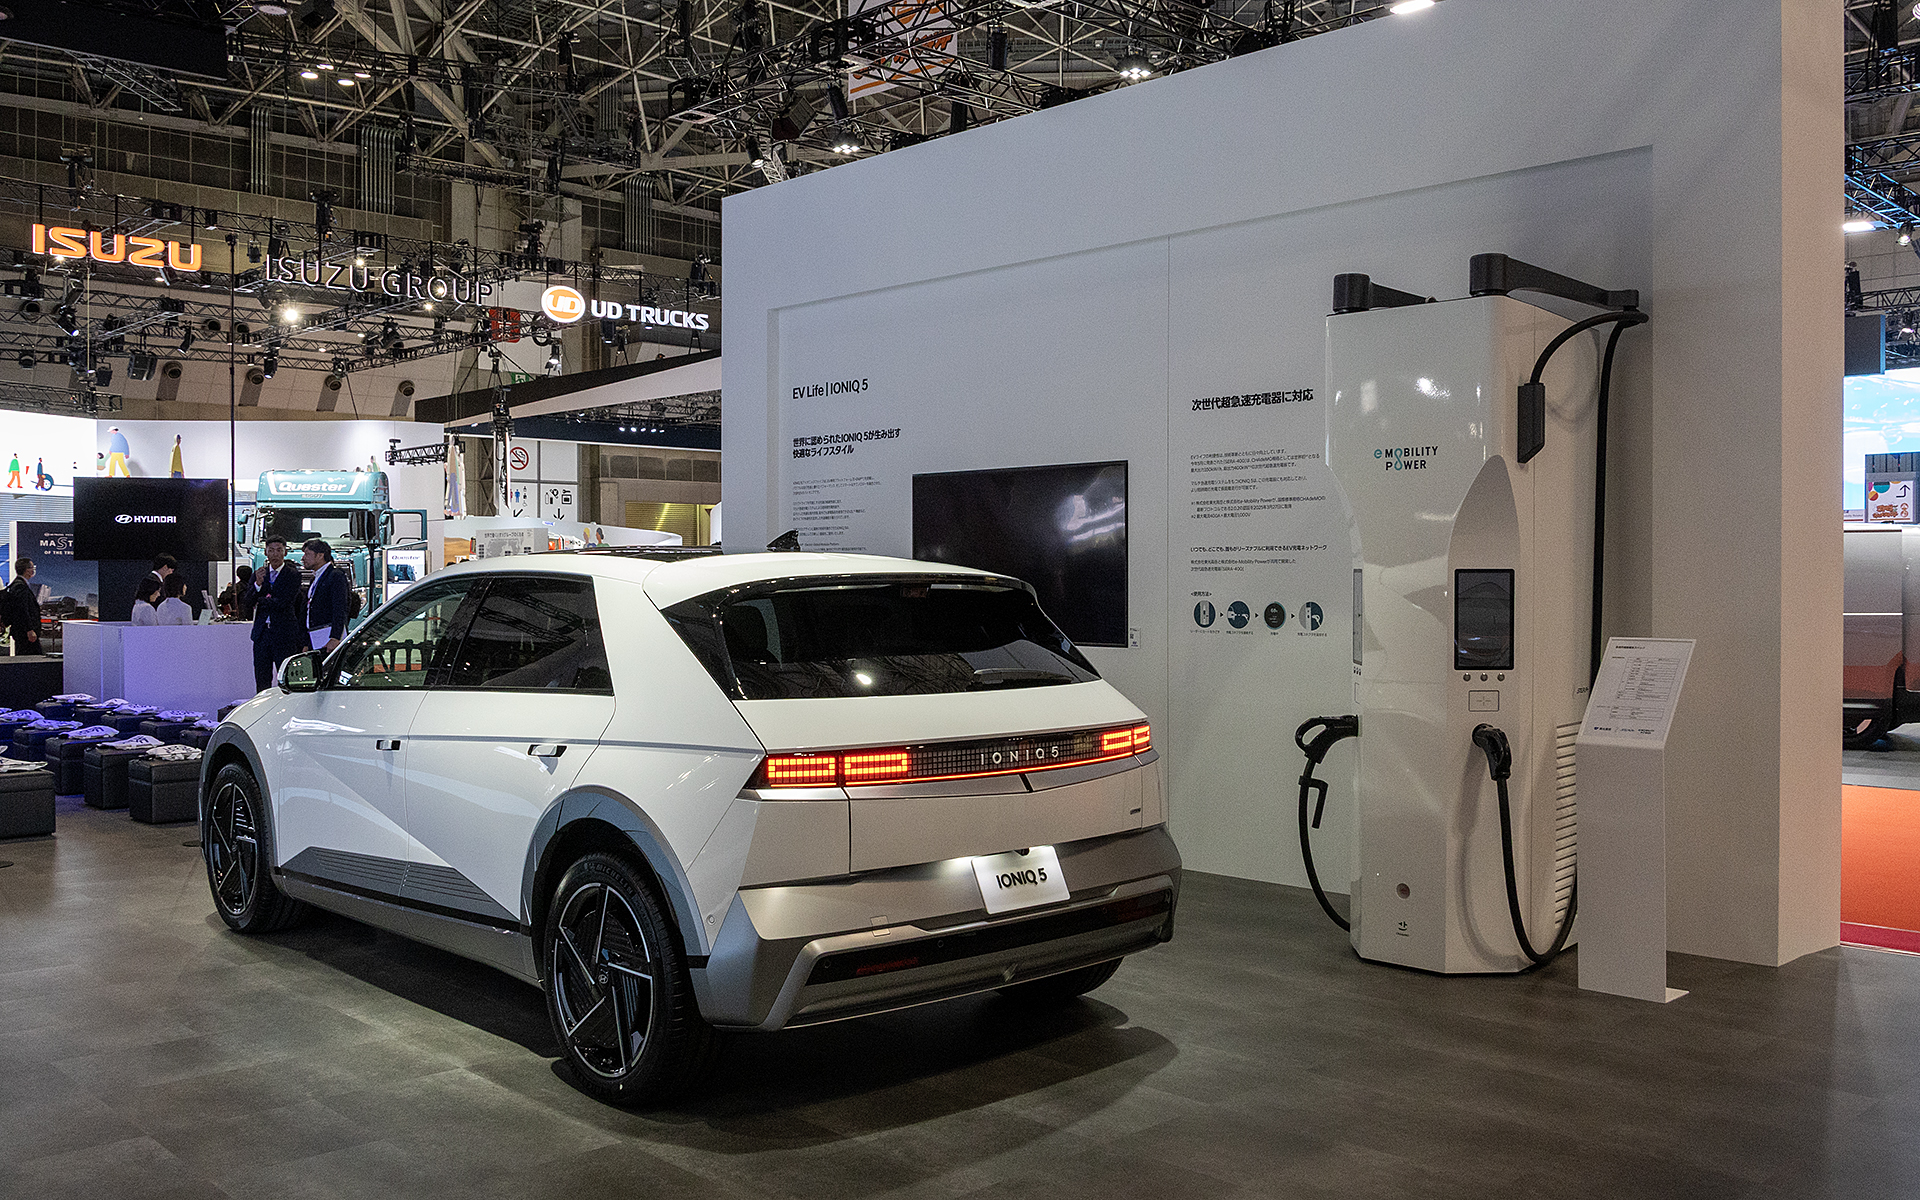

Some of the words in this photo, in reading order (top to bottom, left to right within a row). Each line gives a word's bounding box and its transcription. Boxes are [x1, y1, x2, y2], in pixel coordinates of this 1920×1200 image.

[32, 223, 202, 272] ISUZU
[266, 254, 368, 292] ISUZU
[381, 269, 493, 306] GROUP
[549, 294, 580, 313] UD
[590, 299, 622, 320] UD
[625, 303, 709, 331] TRUCKS
[793, 387, 805, 399] EV
[807, 384, 824, 398] Life
[830, 380, 860, 395] IONIQ
[861, 379, 869, 391] 5
[1191, 388, 1314, 411] 次世代超急速充電器に対応
[793, 444, 854, 459] 快適なライフスタイル
[1385, 460, 1427, 471] POWER
[278, 482, 347, 492] Quester
[133, 515, 177, 524] HYUNDAI
[980, 748, 1045, 766] IONIQ
[1051, 745, 1059, 758] 5
[995, 869, 1038, 889] IONIQ
[1037, 867, 1048, 882] 5
